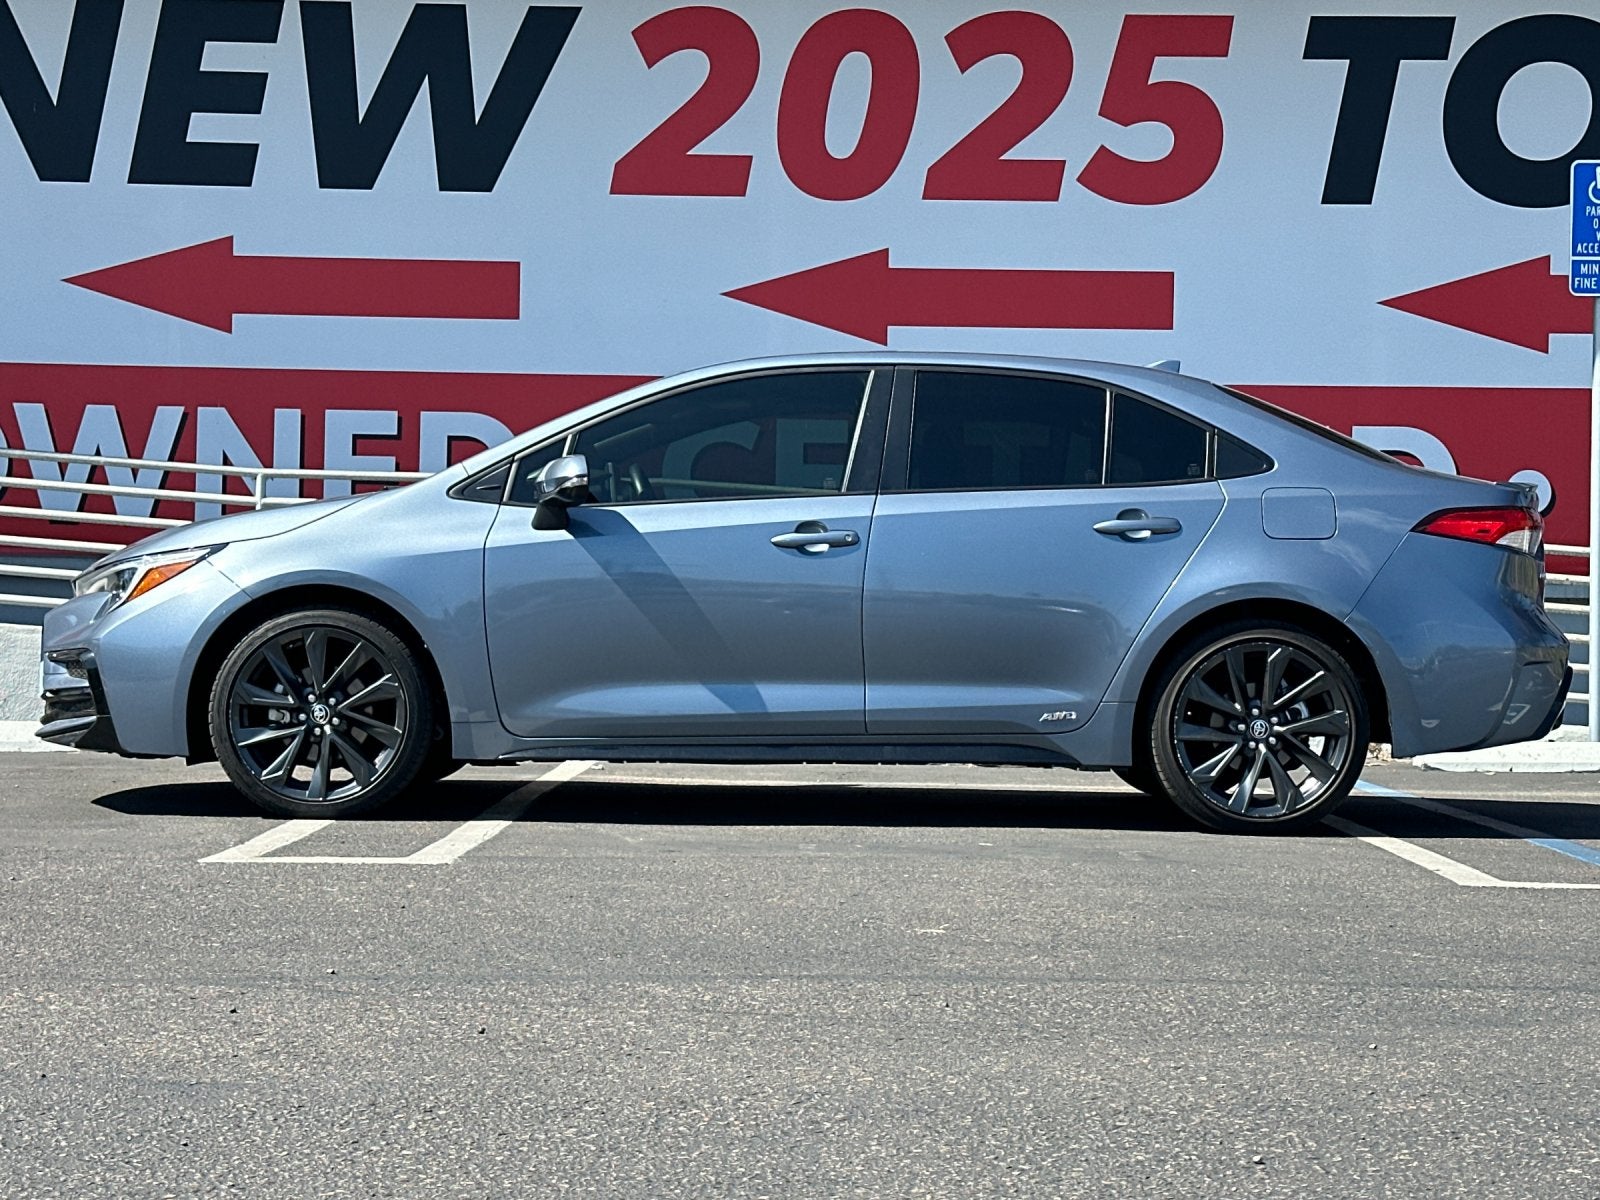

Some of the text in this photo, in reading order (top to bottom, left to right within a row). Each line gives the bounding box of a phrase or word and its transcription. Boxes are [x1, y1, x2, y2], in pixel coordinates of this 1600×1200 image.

[0, 0, 582, 192] NEW
[609, 5, 1234, 205] 2025
[1580, 263, 1599, 275] MIN
[1574, 277, 1598, 289] FINE
[1038, 711, 1077, 722] AWD
